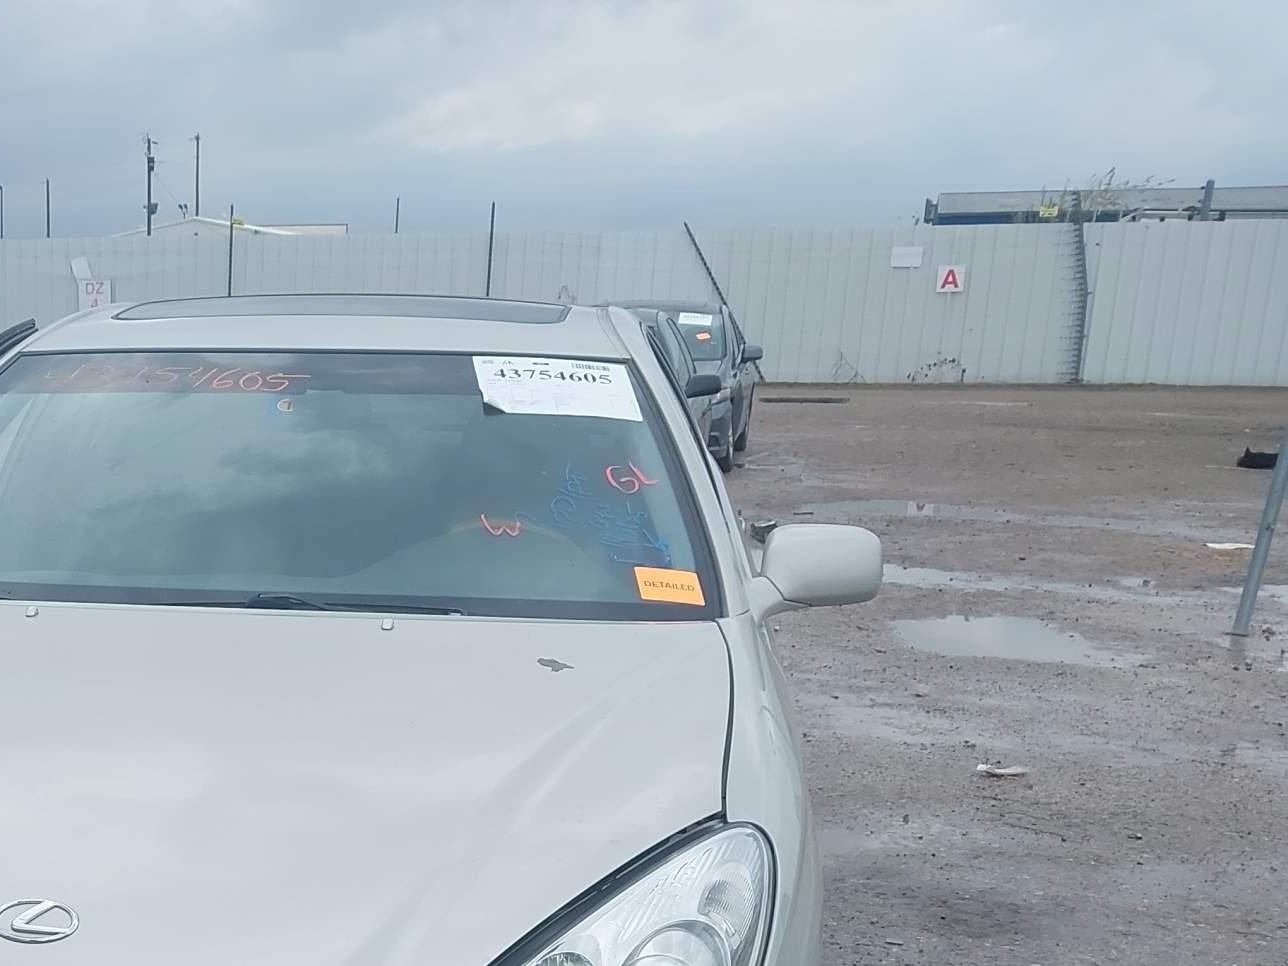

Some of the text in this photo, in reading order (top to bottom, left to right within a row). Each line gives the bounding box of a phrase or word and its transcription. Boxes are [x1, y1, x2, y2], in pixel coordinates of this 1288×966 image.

[940, 268, 960, 289] A
[85, 281, 105, 296] DZ
[493, 368, 613, 385] 43754605
[643, 580, 695, 592] DETAILED
